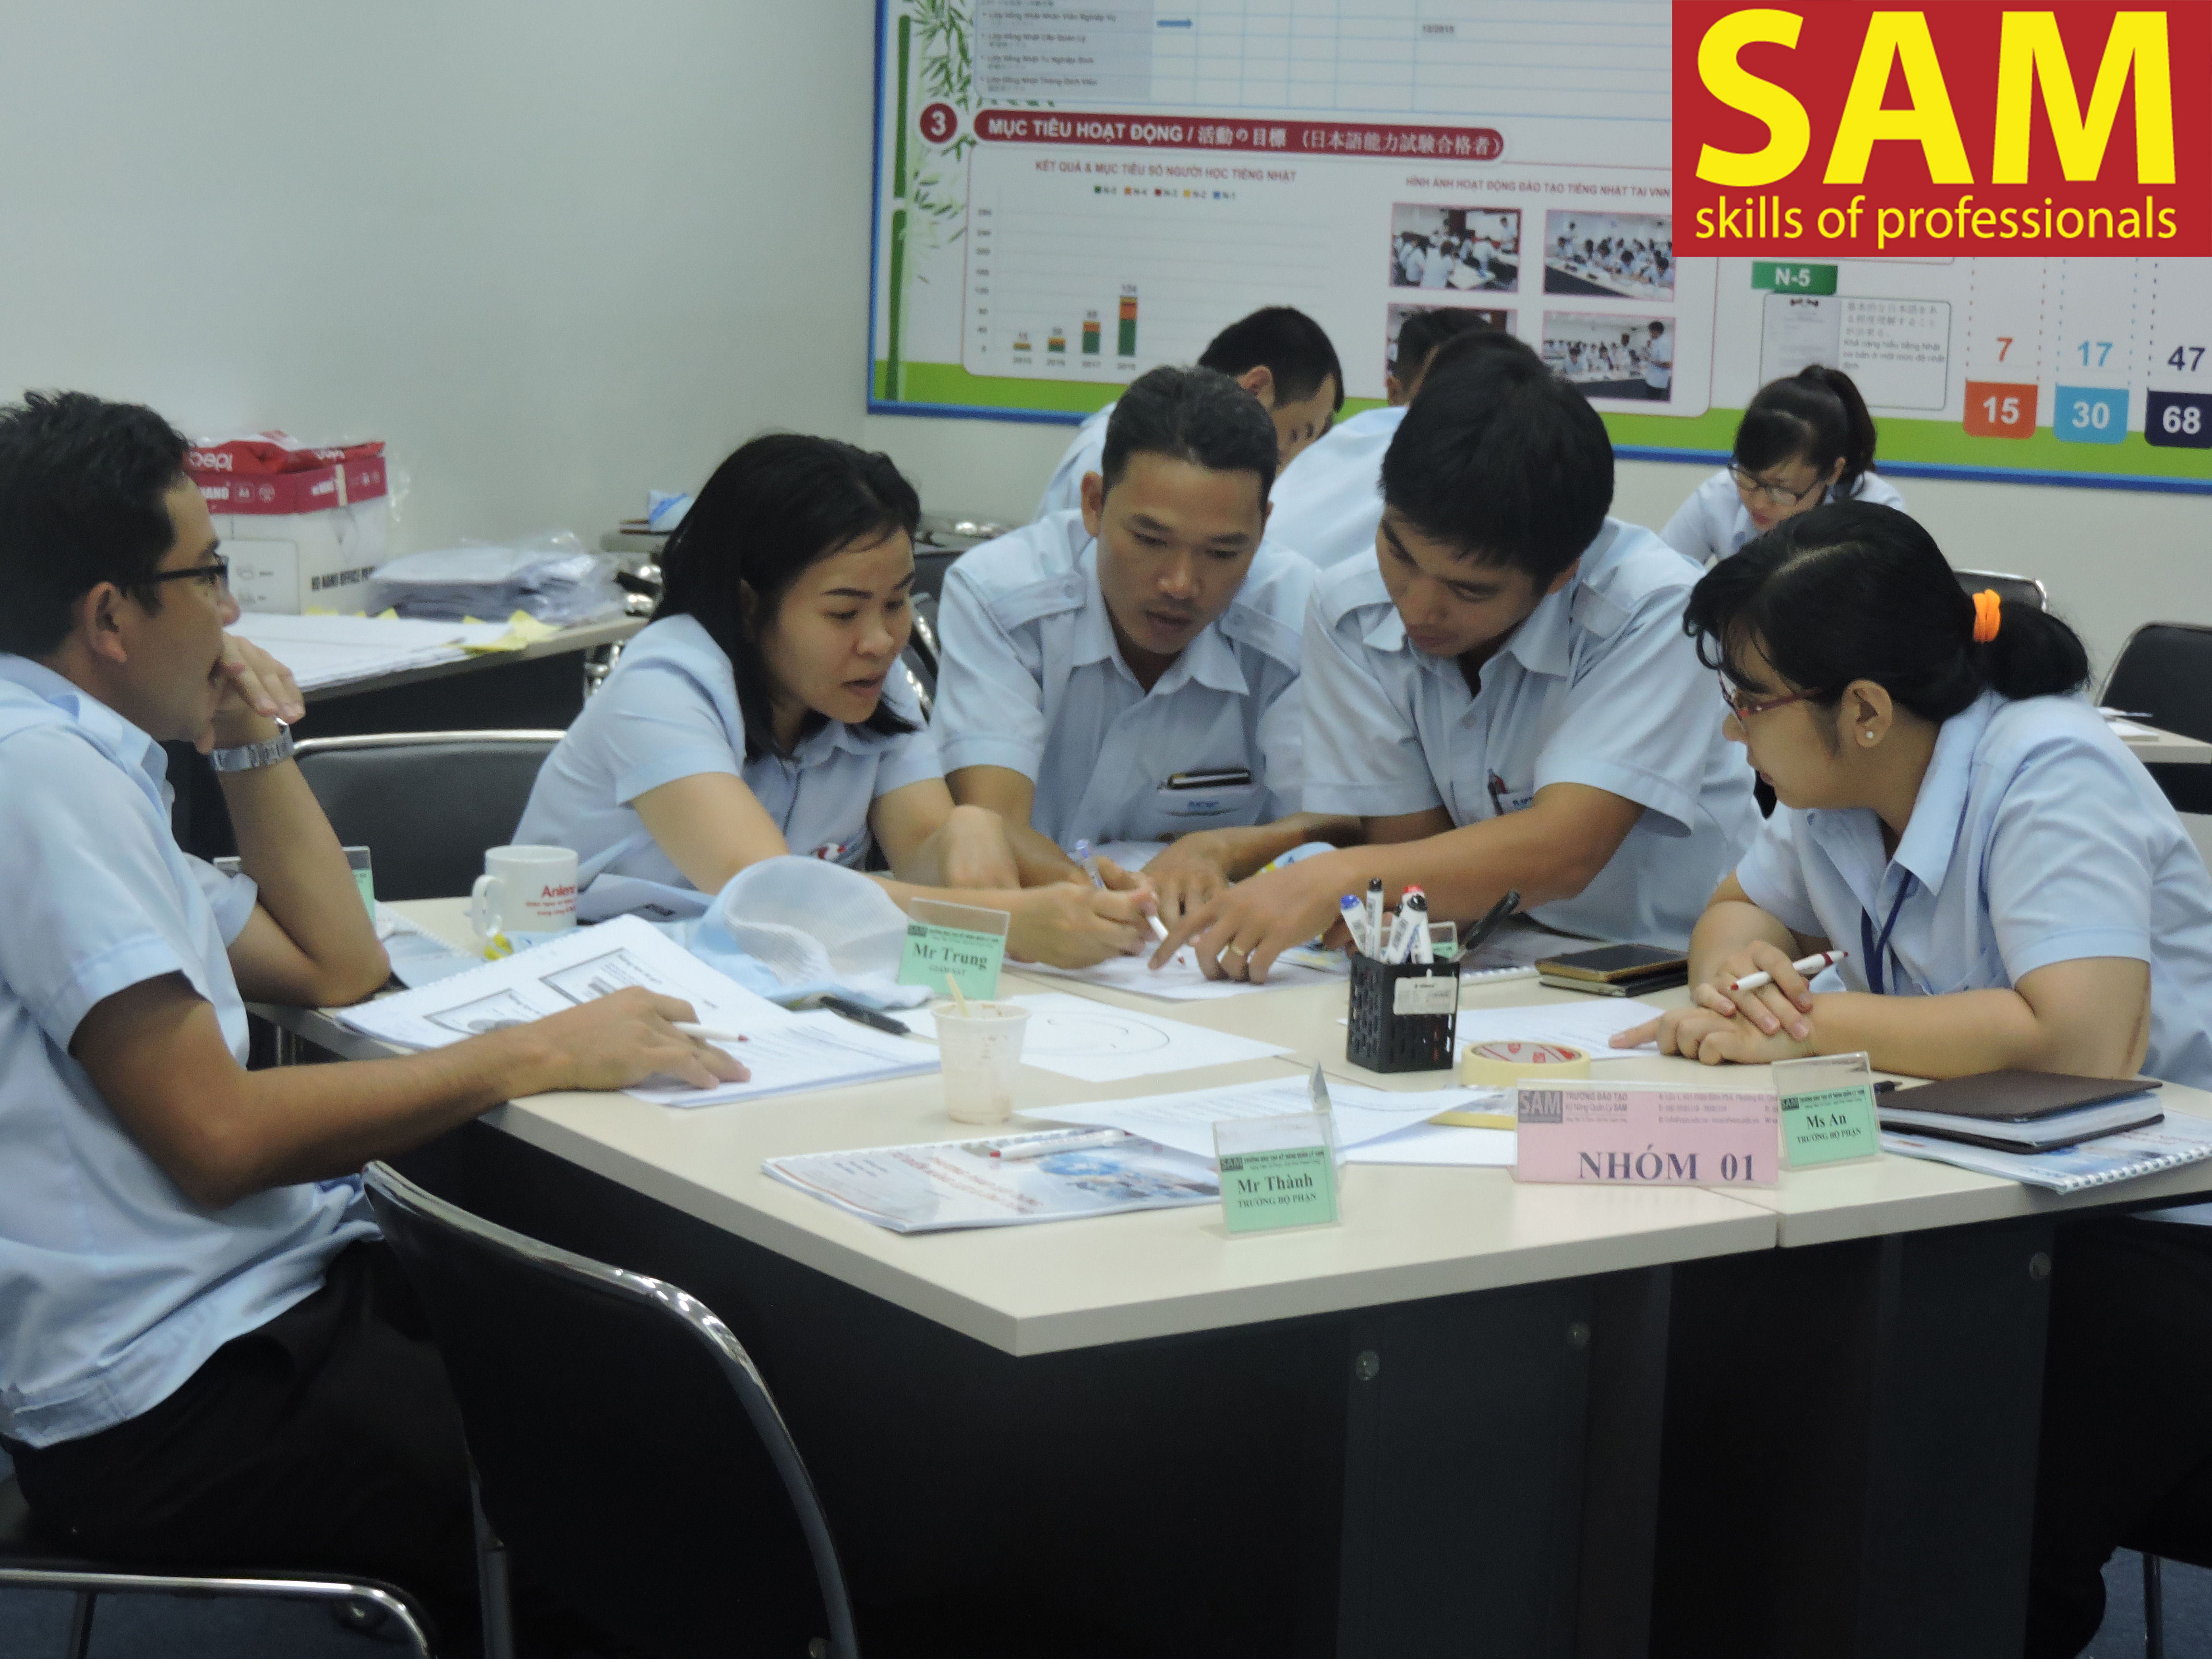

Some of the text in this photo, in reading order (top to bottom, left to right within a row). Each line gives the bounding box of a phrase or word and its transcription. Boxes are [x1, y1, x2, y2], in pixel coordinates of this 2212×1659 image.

[931, 112, 947, 136] 3
[988, 118, 1027, 139] MỤC
[1033, 118, 1071, 138] TIÊU
[1076, 122, 1126, 143] HOẠT
[1776, 267, 1811, 287] N-5
[1996, 337, 2013, 362] 7
[2077, 340, 2113, 367] 17
[2167, 345, 2206, 372] 47
[1983, 396, 2020, 425] 15
[2072, 401, 2110, 430] 30
[2163, 405, 2201, 435] 68
[913, 942, 937, 960] Mr
[941, 946, 988, 971] Trung
[1520, 1091, 1561, 1115] SAM
[1806, 1113, 1847, 1130] Ms An
[1578, 1143, 1755, 1181] NHÓM 01
[1238, 1178, 1260, 1194] Mr
